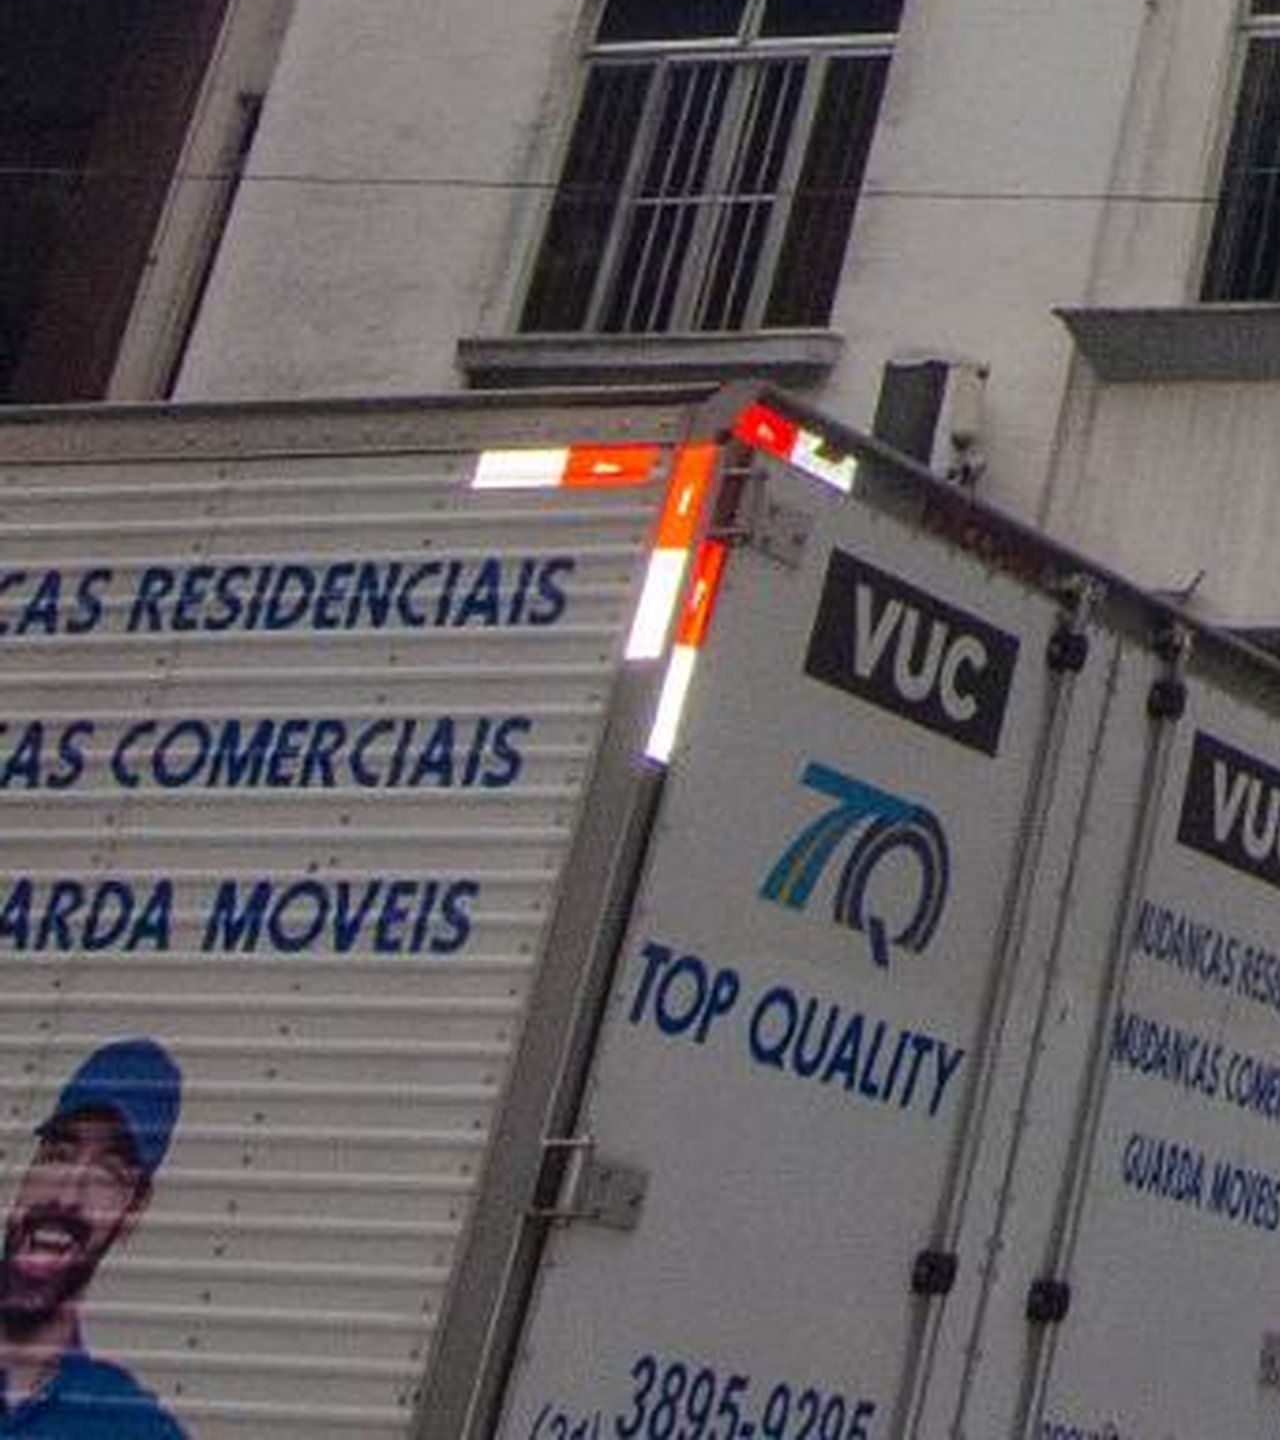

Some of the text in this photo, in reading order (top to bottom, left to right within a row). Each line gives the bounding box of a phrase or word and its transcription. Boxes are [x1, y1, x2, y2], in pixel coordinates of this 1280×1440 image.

[126, 557, 576, 631] RESIDENCIAIS
[853, 583, 989, 721] VUC
[0, 715, 533, 789] AS COMERCIAIS
[628, 941, 965, 1117] TOP QUALITY
[1124, 1133, 1205, 1207] GUARDA
